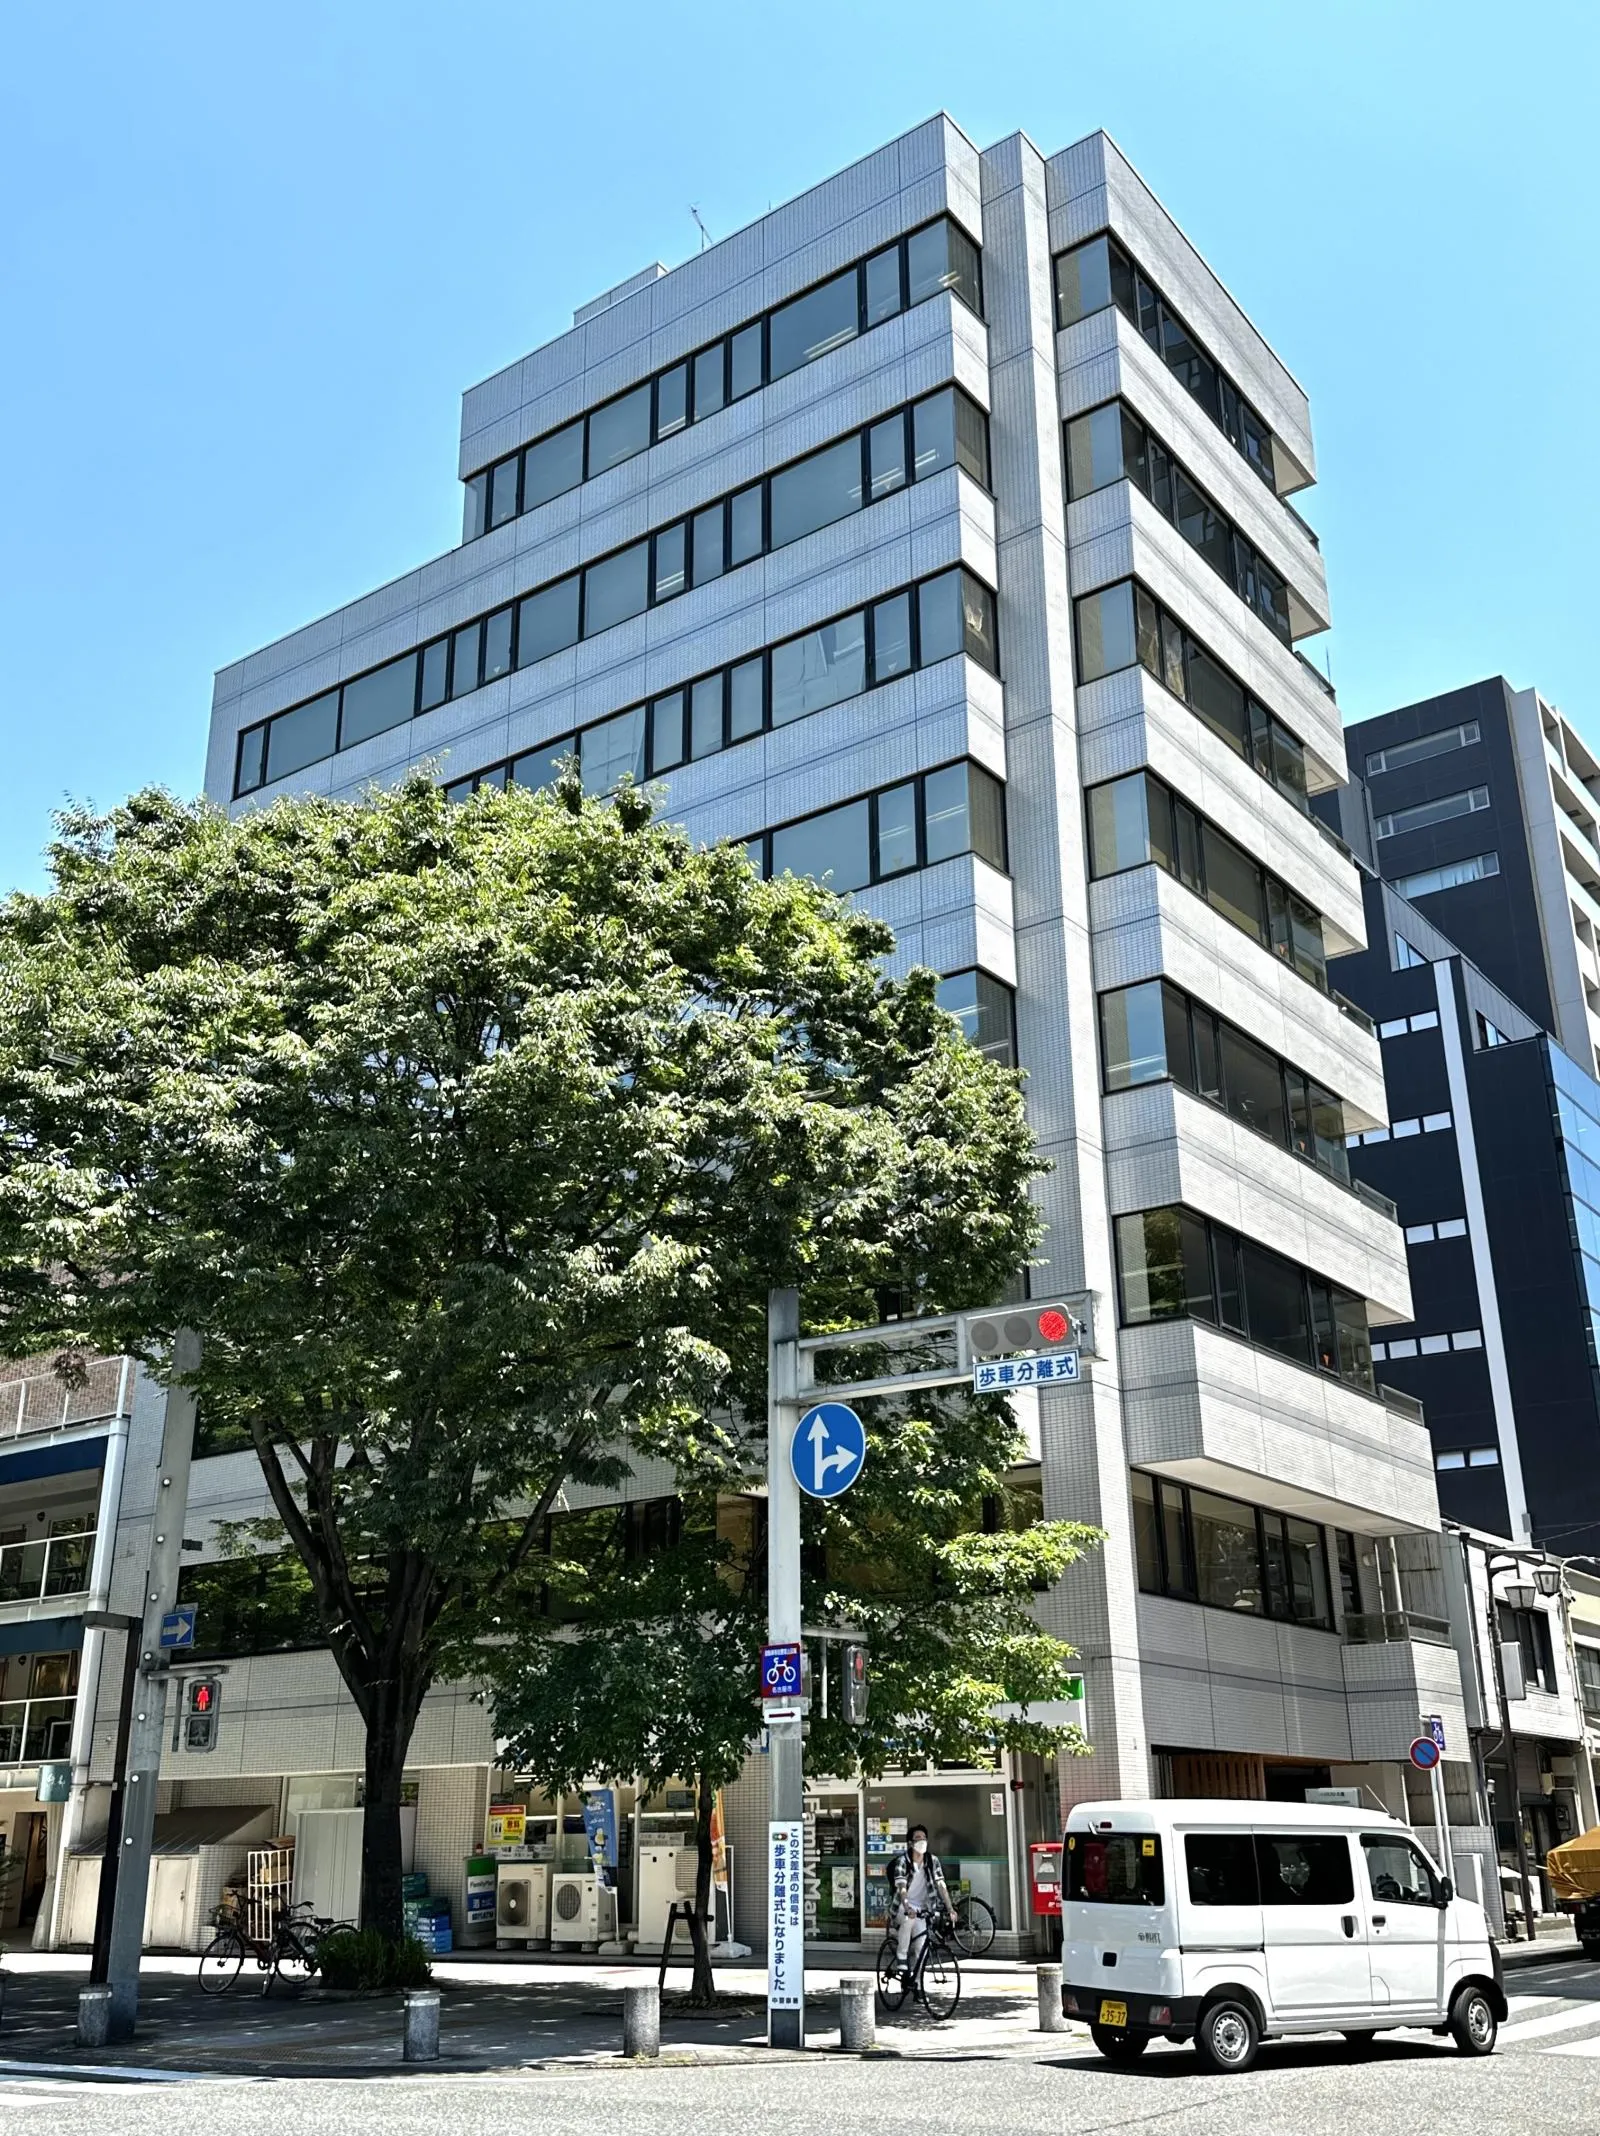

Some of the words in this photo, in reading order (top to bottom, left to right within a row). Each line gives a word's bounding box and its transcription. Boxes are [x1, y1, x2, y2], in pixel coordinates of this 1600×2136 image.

[979, 1355, 1074, 1387] 歩車分離式
[773, 1843, 786, 1992] 歩車分離式になりました
[790, 1828, 800, 1926] この交差点の信号は
[803, 1797, 821, 1937] FamilyMart
